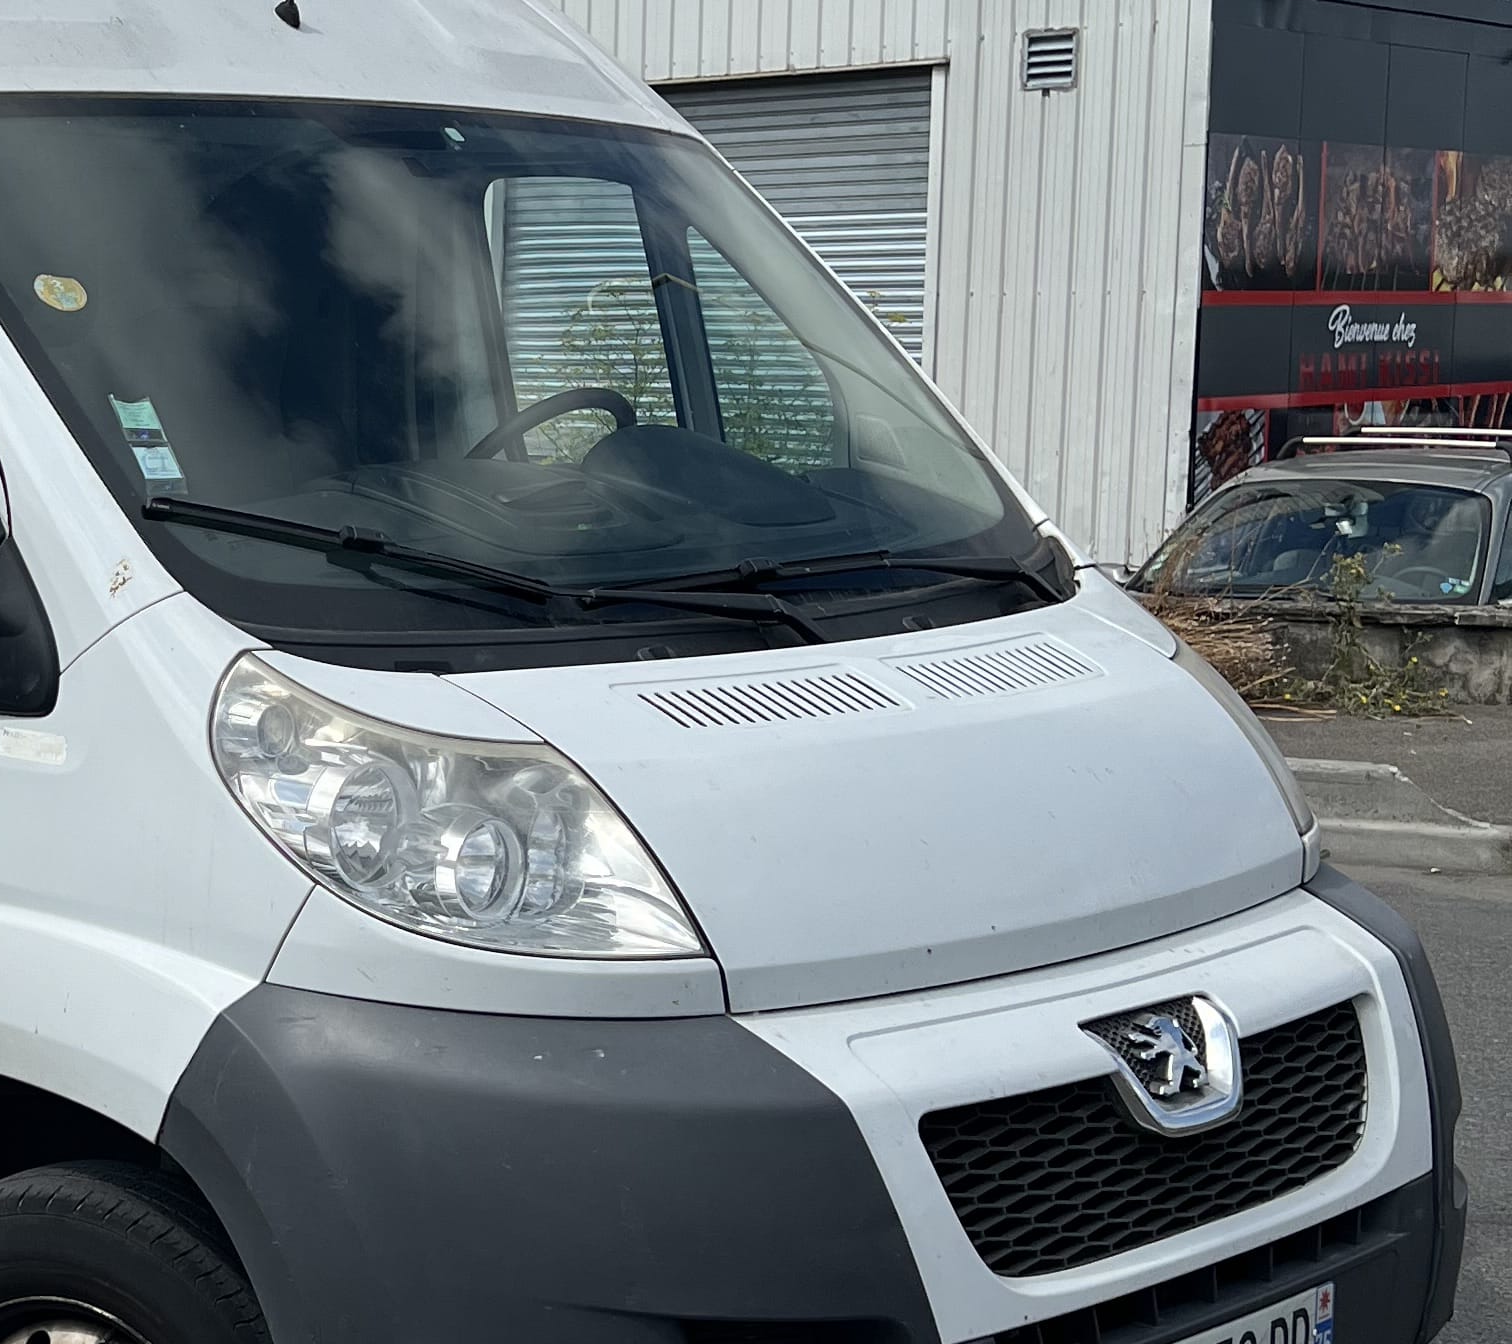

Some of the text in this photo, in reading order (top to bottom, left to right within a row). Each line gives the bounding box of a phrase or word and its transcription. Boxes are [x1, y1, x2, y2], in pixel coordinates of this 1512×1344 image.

[1328, 304, 1416, 348] Bienvenue chez
[1299, 349, 1440, 391] HAMI KISSI
